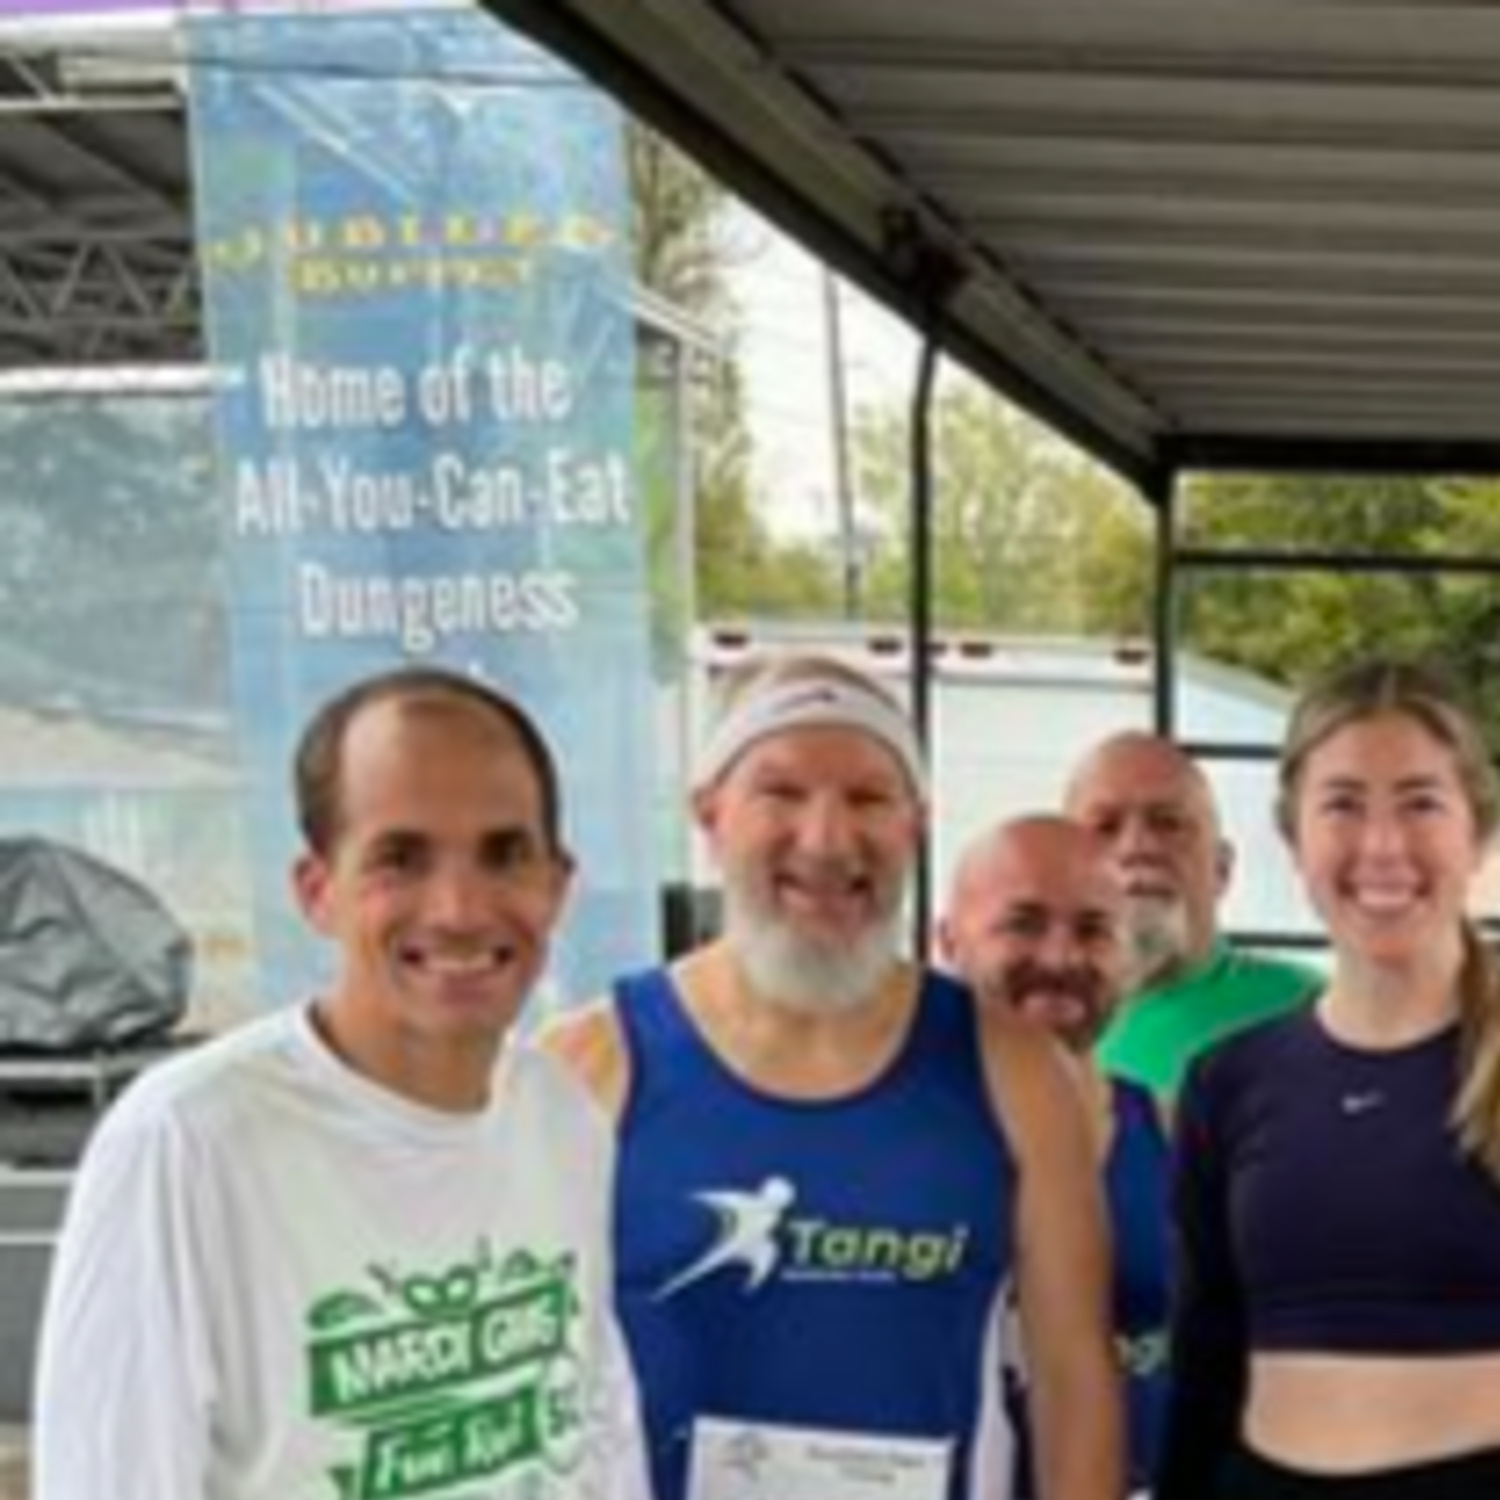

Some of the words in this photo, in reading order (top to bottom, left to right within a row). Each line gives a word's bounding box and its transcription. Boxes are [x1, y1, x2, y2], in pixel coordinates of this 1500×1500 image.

[262, 355, 404, 428] Home
[418, 347, 475, 424] of
[488, 347, 571, 417] the
[236, 448, 631, 536] All-You-Can-Eat
[299, 562, 580, 652] Dungeness
[786, 1219, 970, 1282] Tangi
[328, 1325, 472, 1404] MARDI
